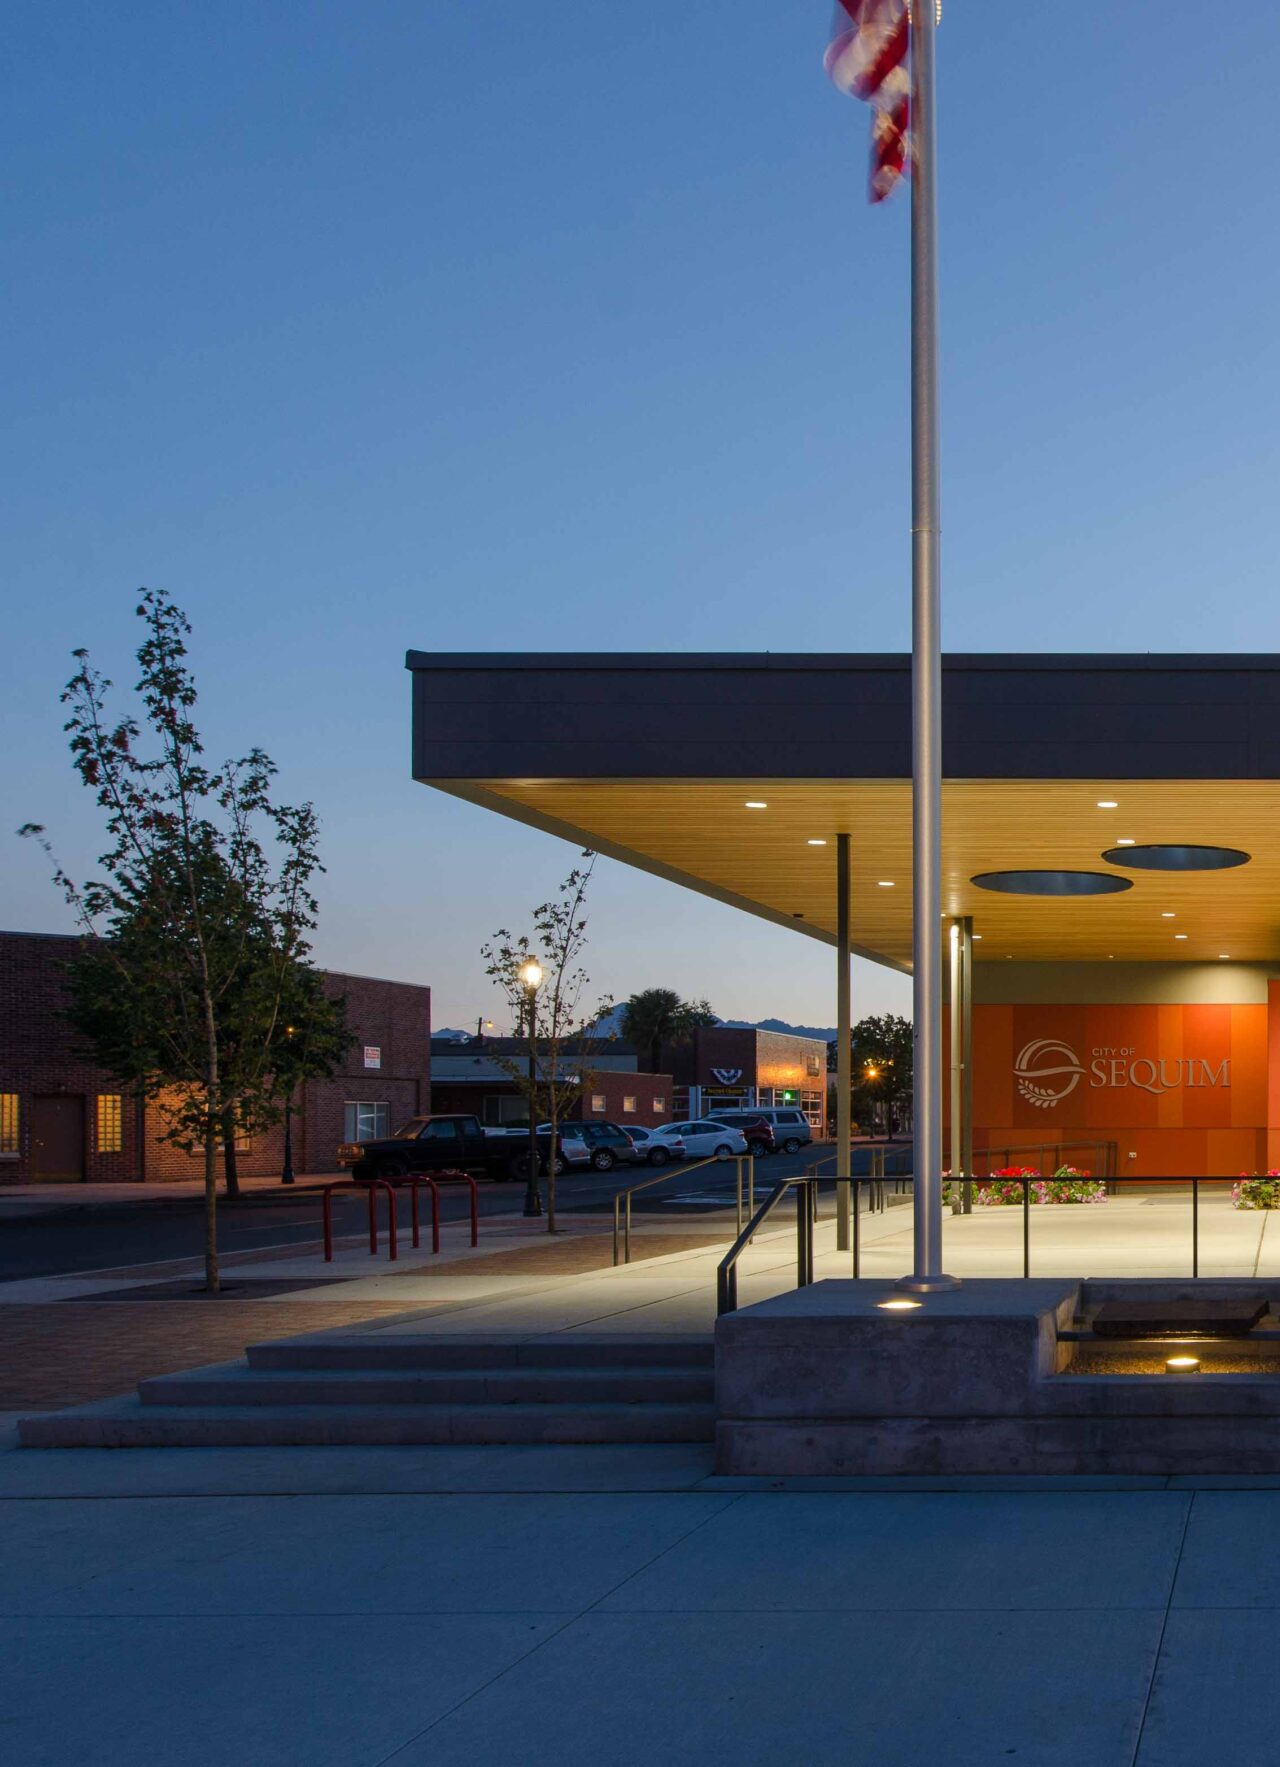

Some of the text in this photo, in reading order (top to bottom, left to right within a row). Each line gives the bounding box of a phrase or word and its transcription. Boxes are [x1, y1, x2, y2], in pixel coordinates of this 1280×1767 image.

[1091, 1047, 1136, 1057] CITY OF
[1089, 1058, 1232, 1095] SEQUIM
